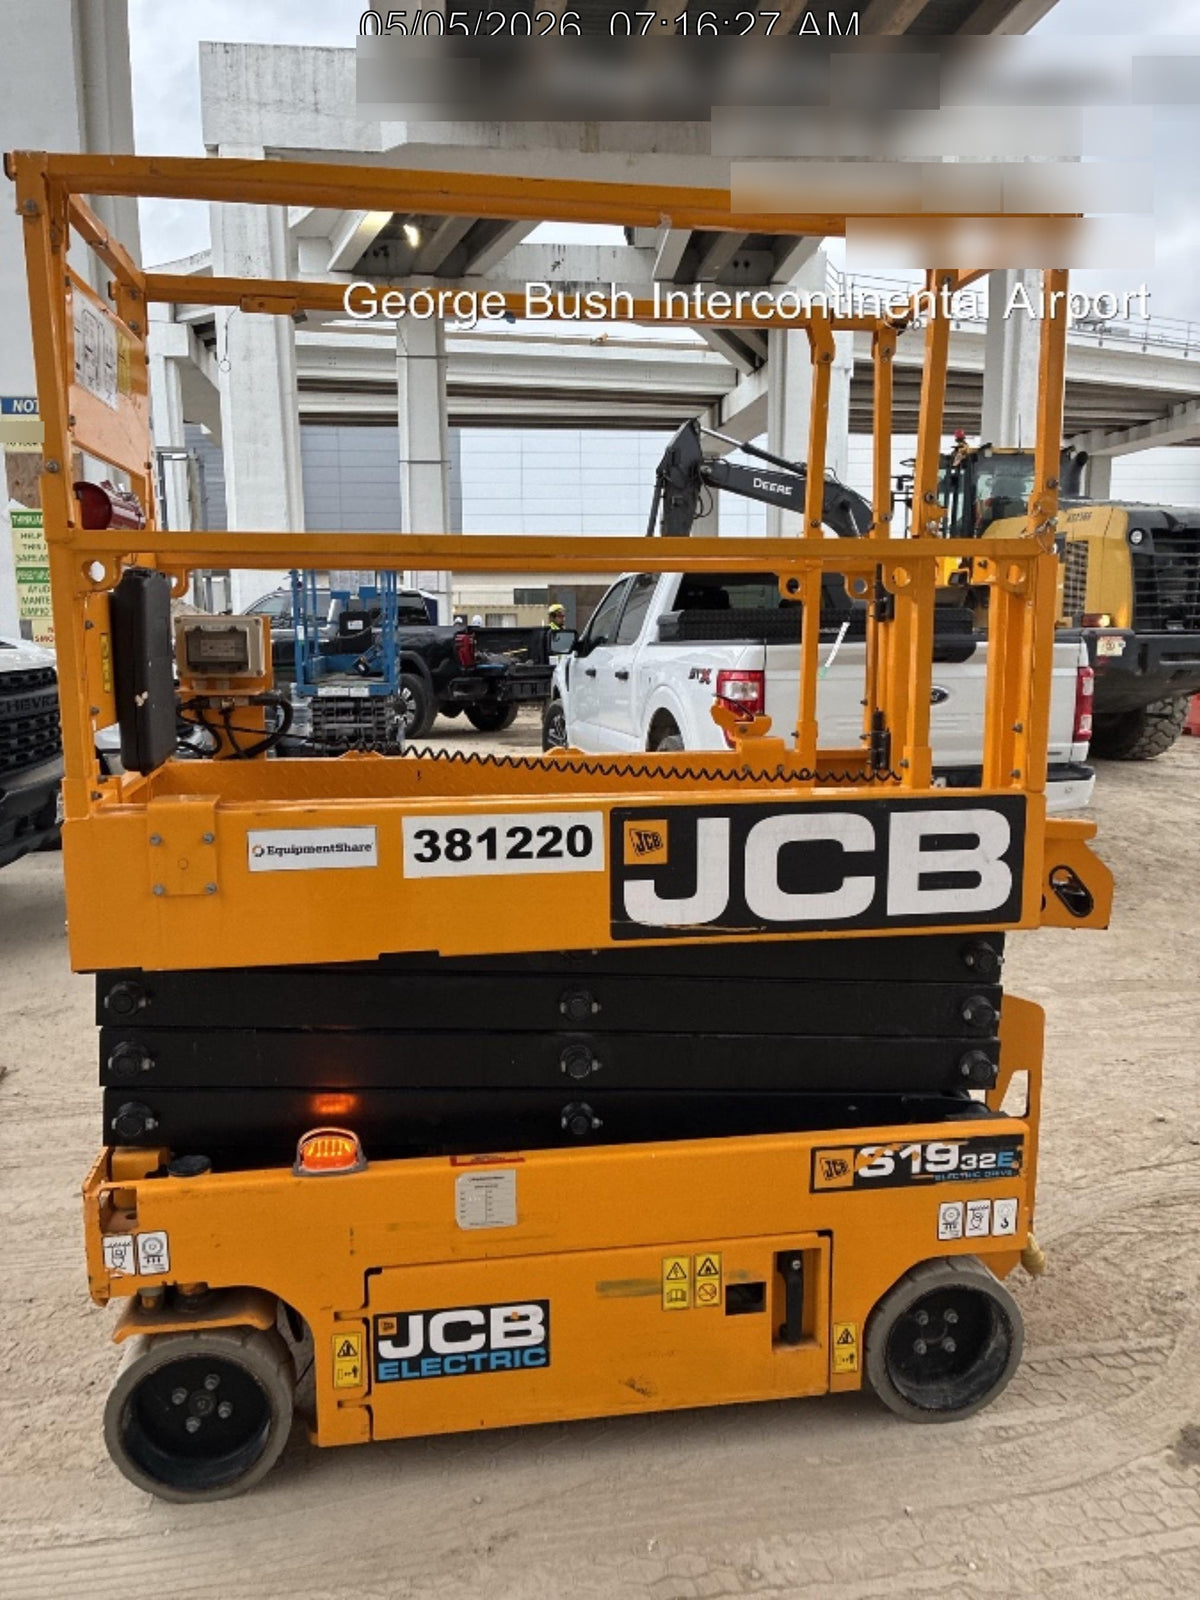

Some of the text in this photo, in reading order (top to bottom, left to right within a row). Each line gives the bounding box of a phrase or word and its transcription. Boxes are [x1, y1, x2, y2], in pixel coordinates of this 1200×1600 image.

[753, 477, 793, 496] DEERE
[266, 842, 374, 857] EquipmentShare
[413, 824, 593, 863] 381220
[634, 831, 663, 853] JCB
[624, 808, 1013, 927] JCB
[378, 1304, 546, 1359] JCB
[378, 1347, 547, 1381] ELECTRIC
